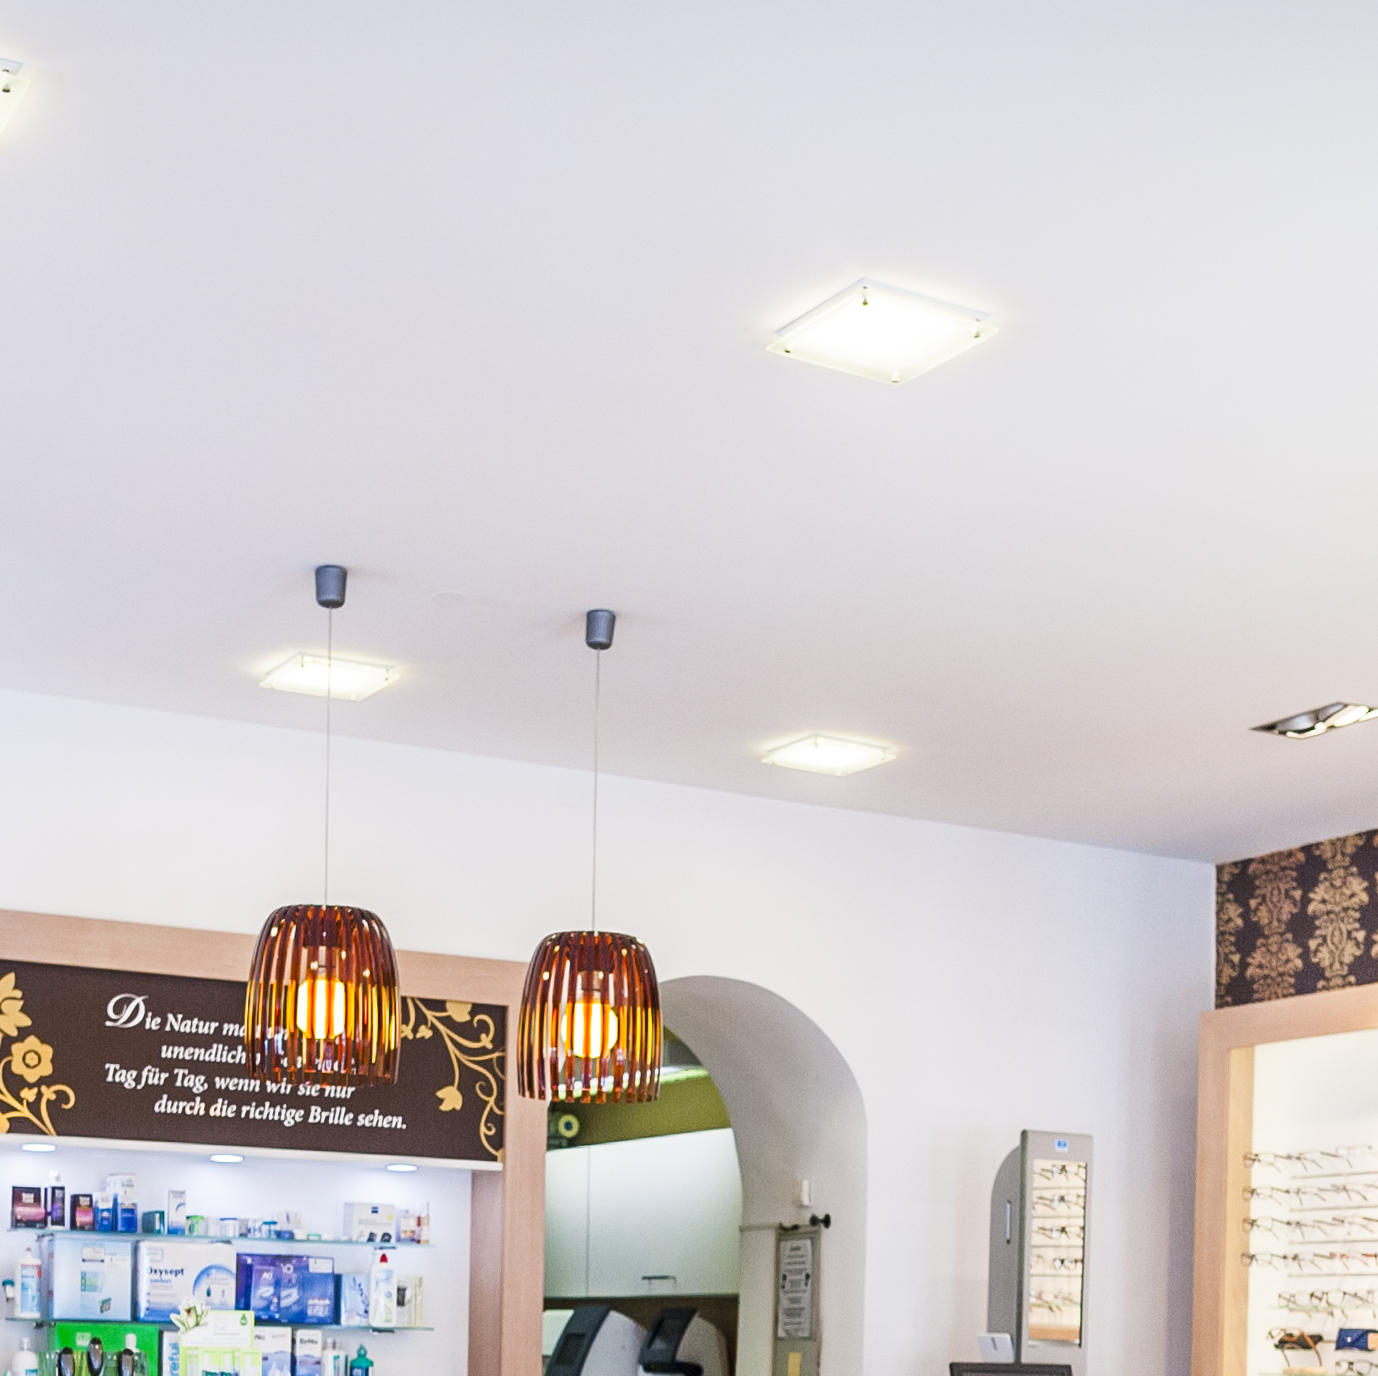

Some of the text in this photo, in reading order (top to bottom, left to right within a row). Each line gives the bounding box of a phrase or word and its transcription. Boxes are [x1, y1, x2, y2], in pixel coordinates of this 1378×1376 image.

[105, 993, 161, 1030] Die
[165, 1013, 220, 1035] Natur
[161, 1043, 247, 1065] unendlich
[105, 1063, 356, 1099] Tag für Tag, wenn wir sie nur
[154, 1094, 407, 1130] durch die richtige Brille sehen.
